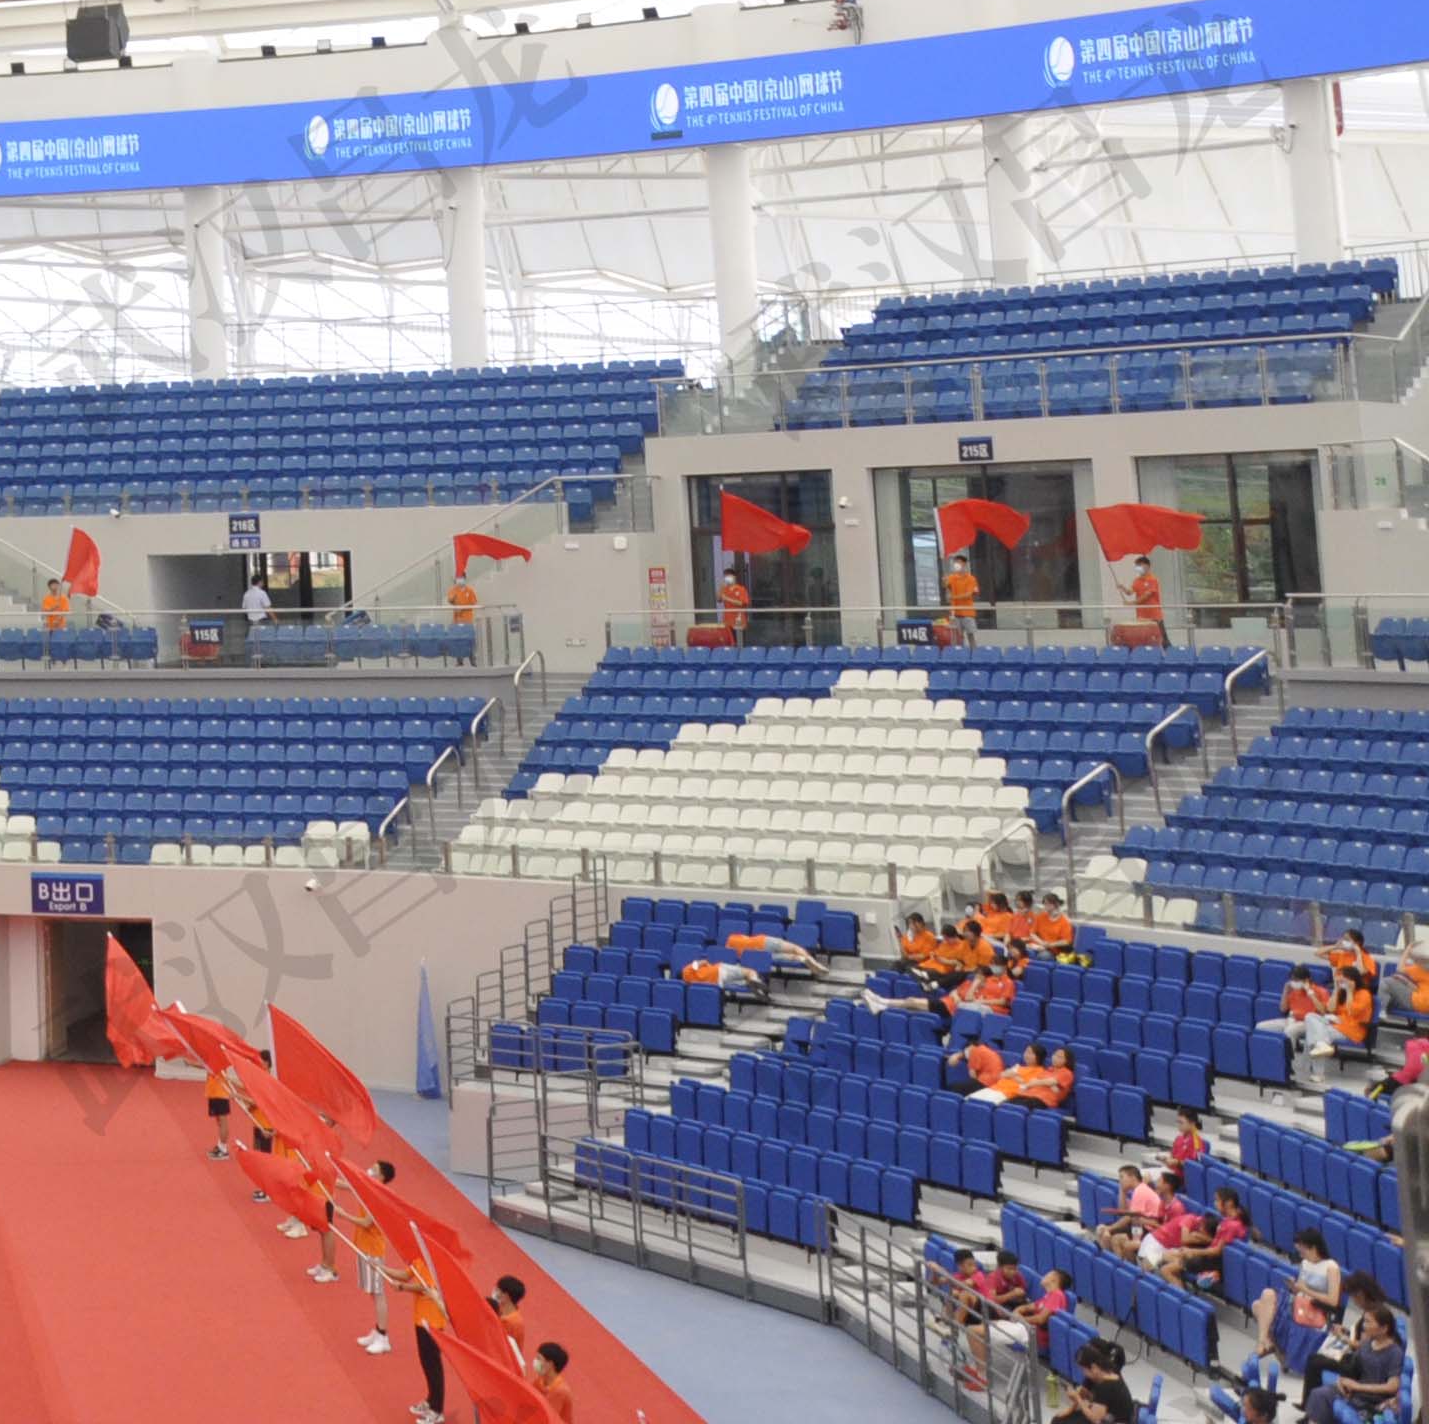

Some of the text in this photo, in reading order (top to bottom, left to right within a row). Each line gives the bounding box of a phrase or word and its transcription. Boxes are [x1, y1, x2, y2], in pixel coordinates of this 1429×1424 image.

[1156, 57, 1204, 75] FESTIVAL
[1222, 51, 1256, 66] CHINA
[753, 105, 798, 122] FESTIVAL
[813, 100, 844, 114] CHINA
[962, 444, 989, 458] 215区
[901, 627, 929, 642] 114区
